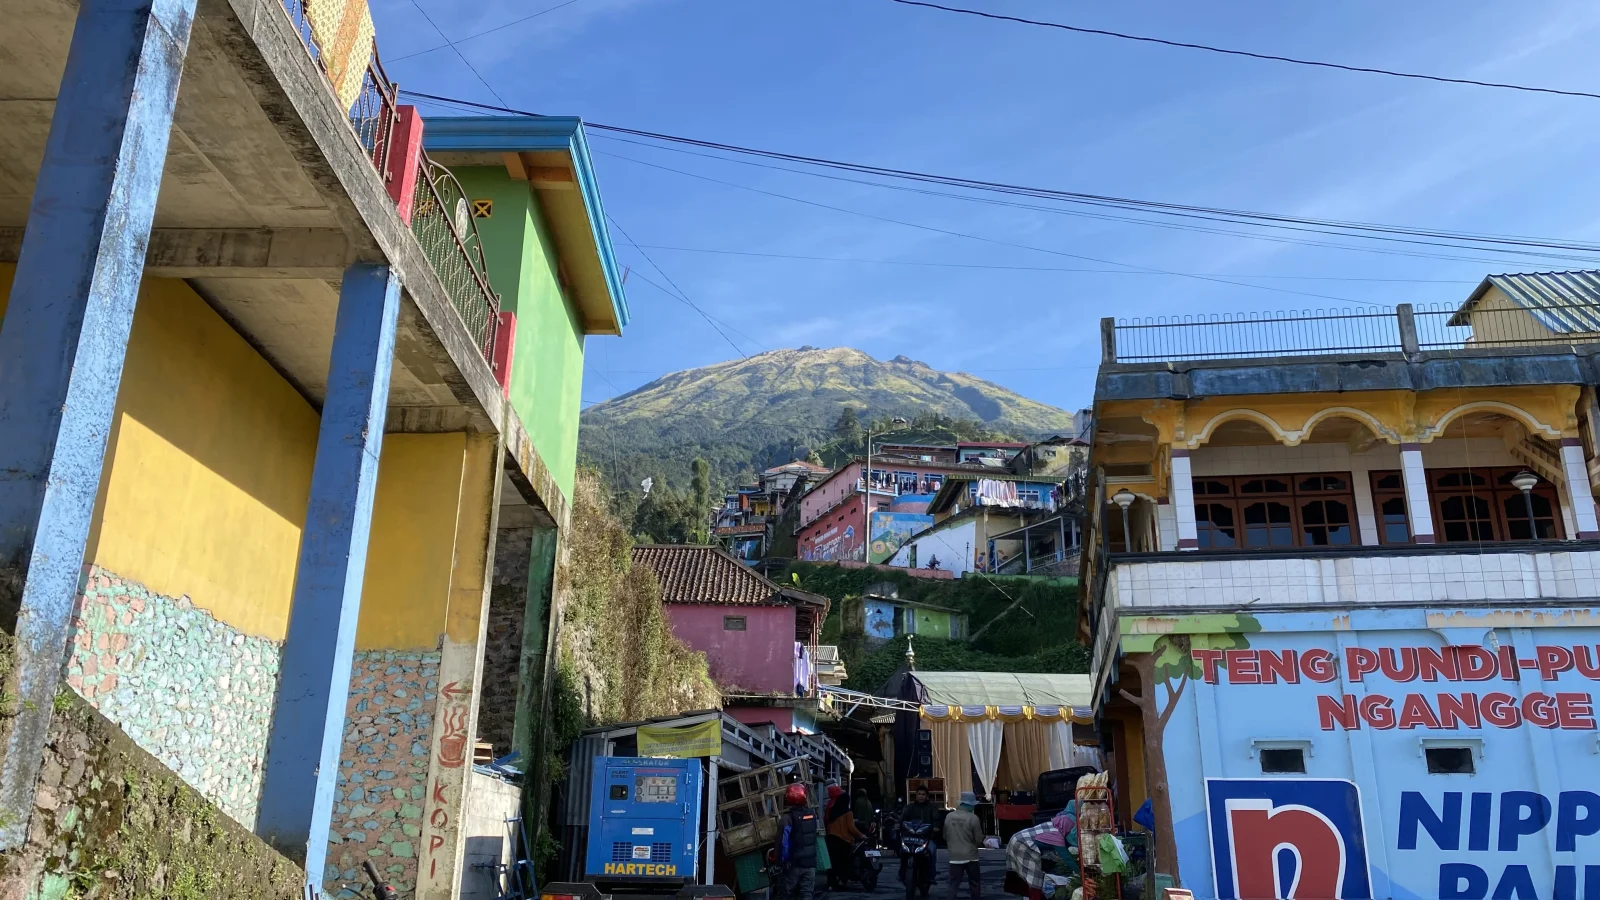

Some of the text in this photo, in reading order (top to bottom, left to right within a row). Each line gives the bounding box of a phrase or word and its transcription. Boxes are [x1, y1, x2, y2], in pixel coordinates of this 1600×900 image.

[1191, 649, 1338, 685] TENG
[1316, 692, 1597, 731] NGANGGE
[429, 778, 449, 880] KOPI
[1397, 790, 1600, 852] NIPP
[604, 862, 676, 876] HARTECH
[1438, 863, 1600, 900] PAI
